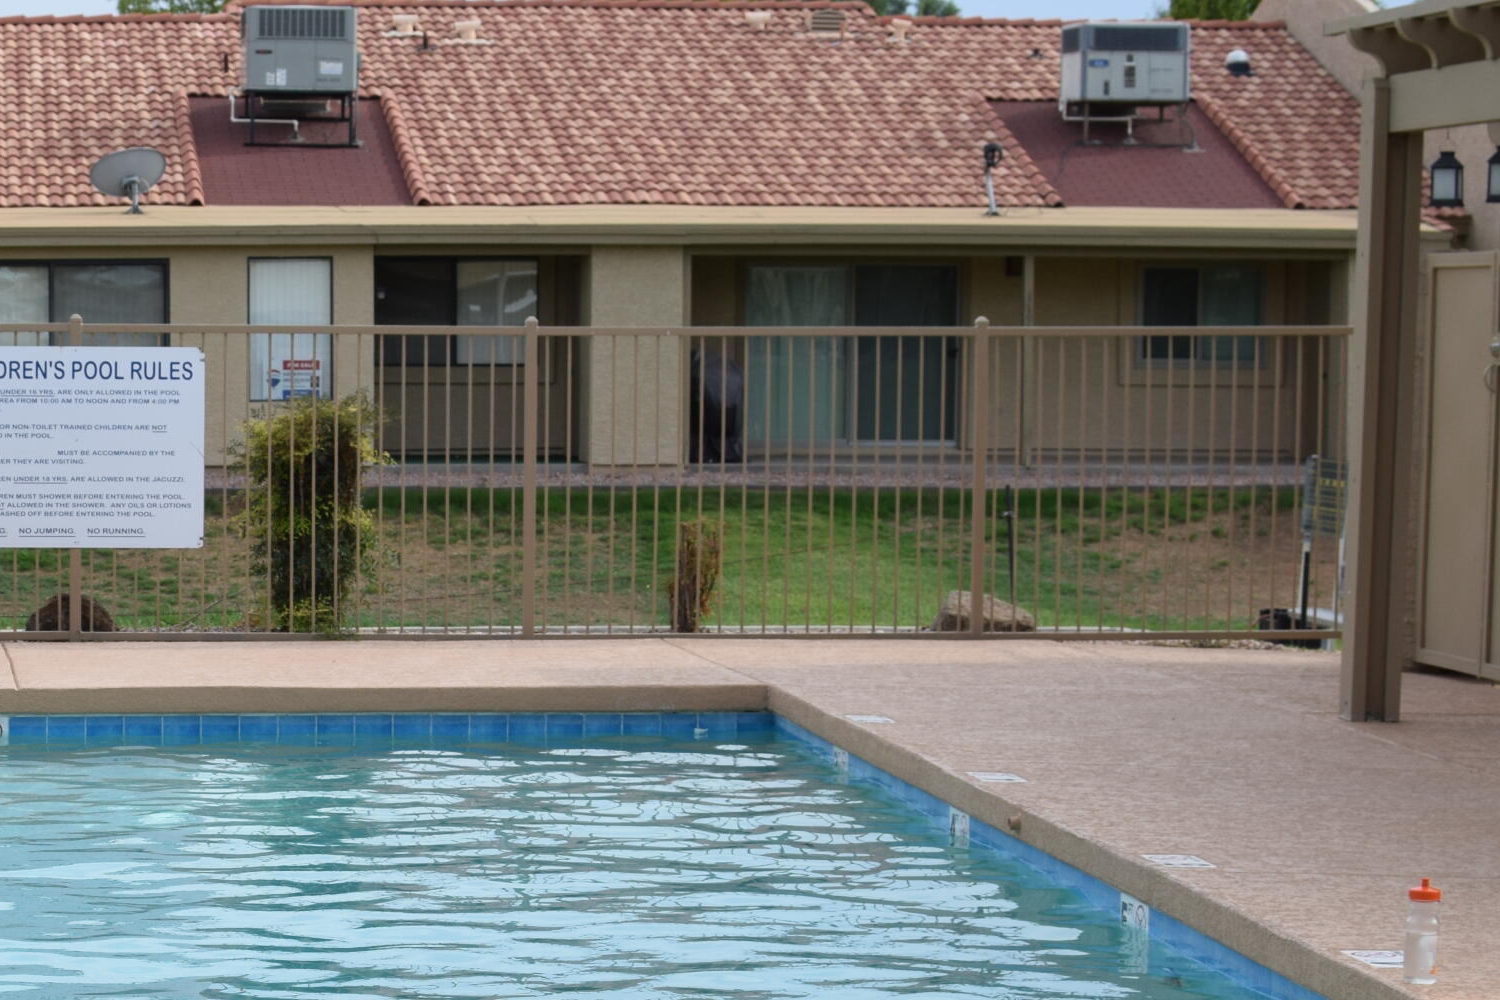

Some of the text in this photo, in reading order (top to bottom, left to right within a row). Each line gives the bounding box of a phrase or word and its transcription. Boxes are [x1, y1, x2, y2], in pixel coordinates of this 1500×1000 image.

[72, 361, 124, 380] POOL
[130, 361, 193, 380] RULES
[18, 527, 32, 535] NO
[86, 527, 101, 535] NO
